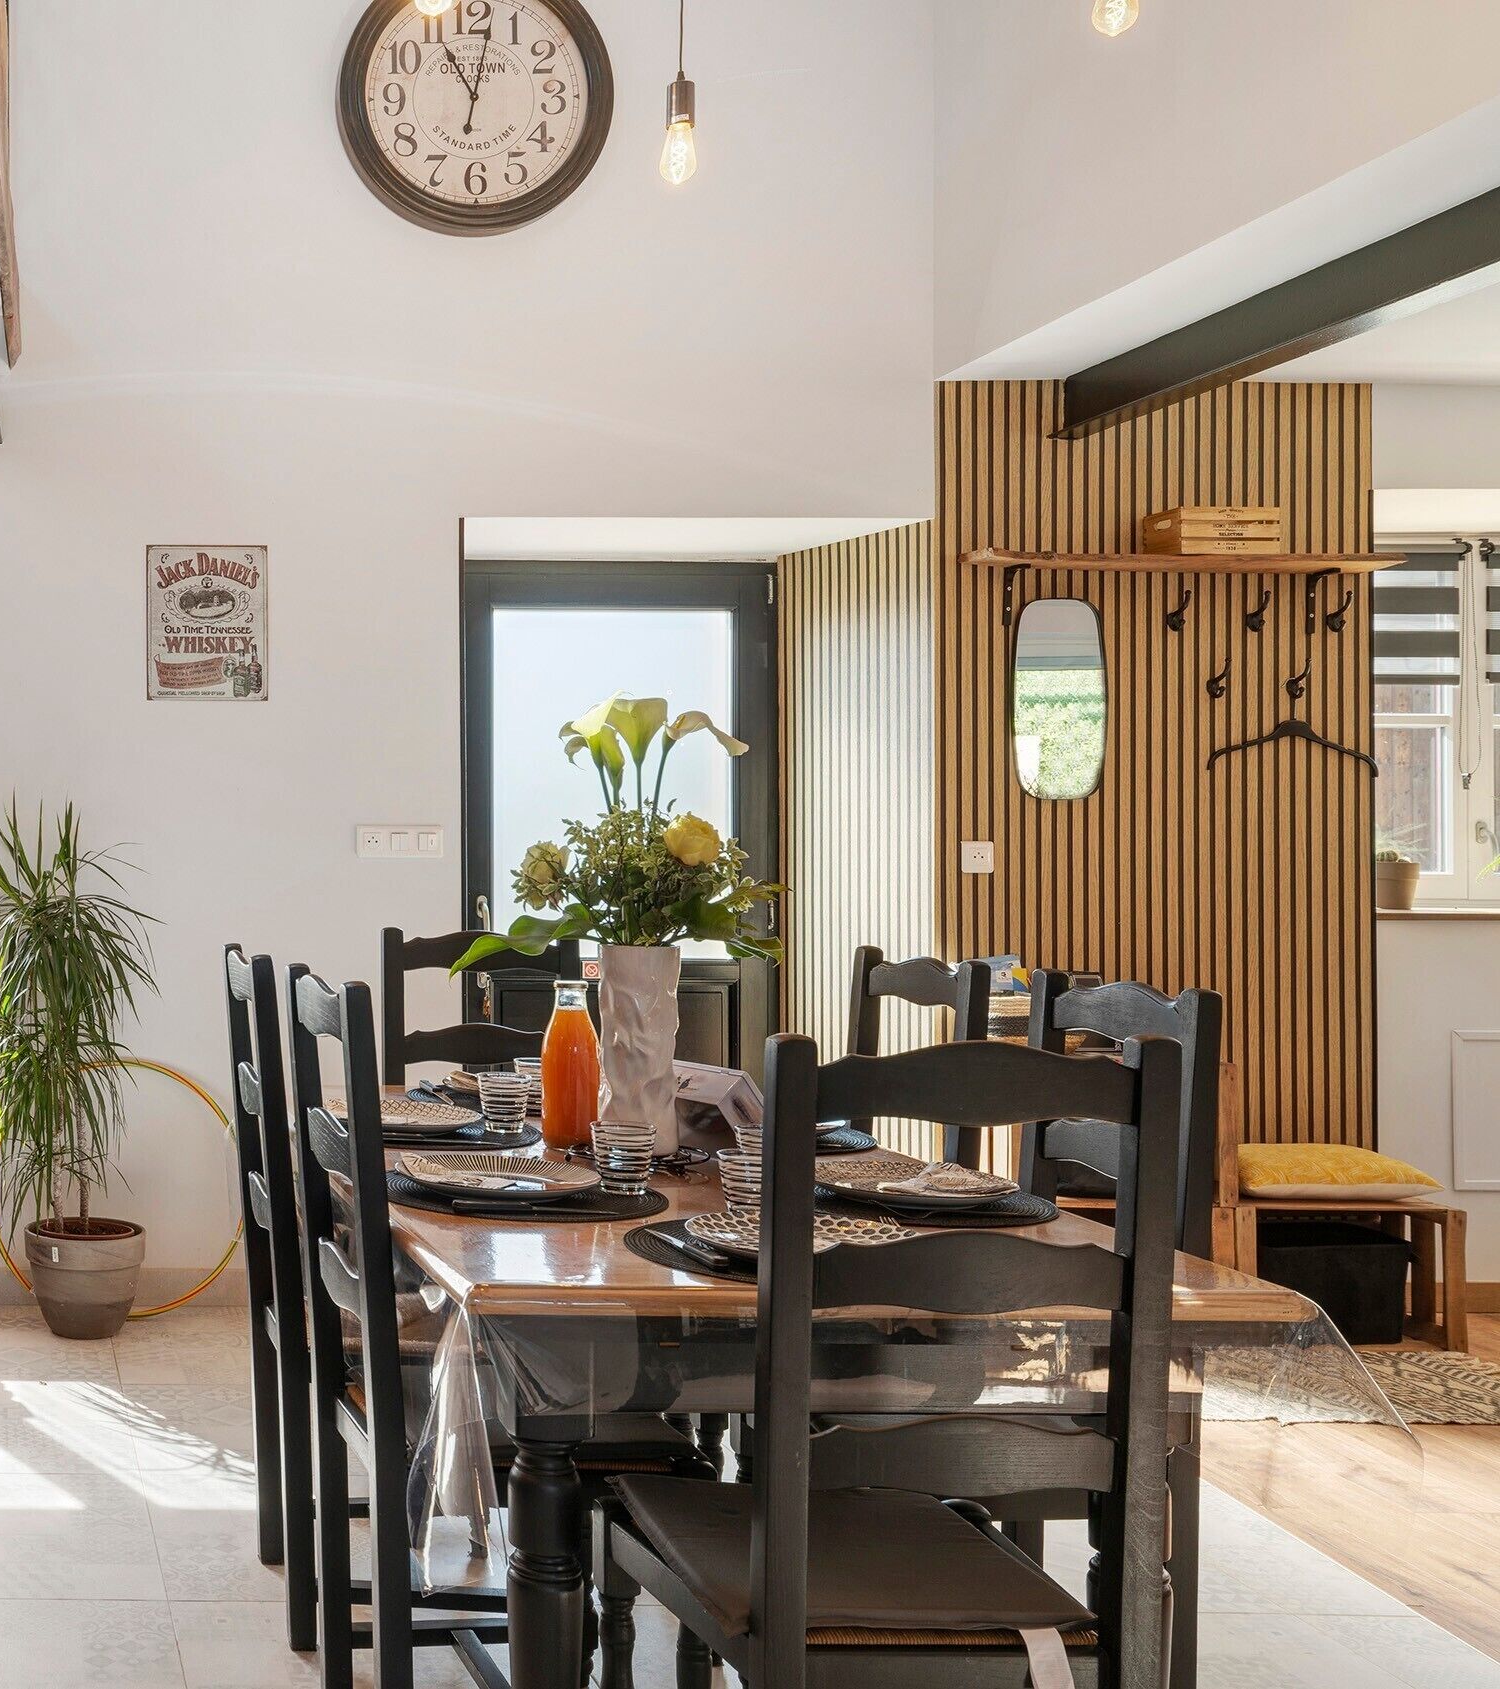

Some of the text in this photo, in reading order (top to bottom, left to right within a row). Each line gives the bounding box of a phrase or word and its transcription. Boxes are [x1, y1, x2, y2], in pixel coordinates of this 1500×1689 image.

[421, 14, 445, 44] 11
[453, 1, 492, 35] 12
[508, 11, 522, 45] 1
[388, 40, 422, 75] 10
[440, 62, 506, 74] OLD TOWN
[462, 43, 521, 76] RESTORATIONS
[531, 40, 556, 75] 2
[382, 83, 406, 116] 9
[541, 80, 566, 115] 3
[393, 123, 418, 157] 8
[432, 124, 517, 151] STANDARD TIME
[526, 121, 555, 153] 4
[424, 154, 448, 187] 7
[464, 161, 488, 196] 6
[504, 151, 528, 186] 5
[154, 558, 197, 589] JACK
[164, 625, 253, 635] OLD TIME TENNESSEE
[164, 636, 255, 654] WHISKEY
